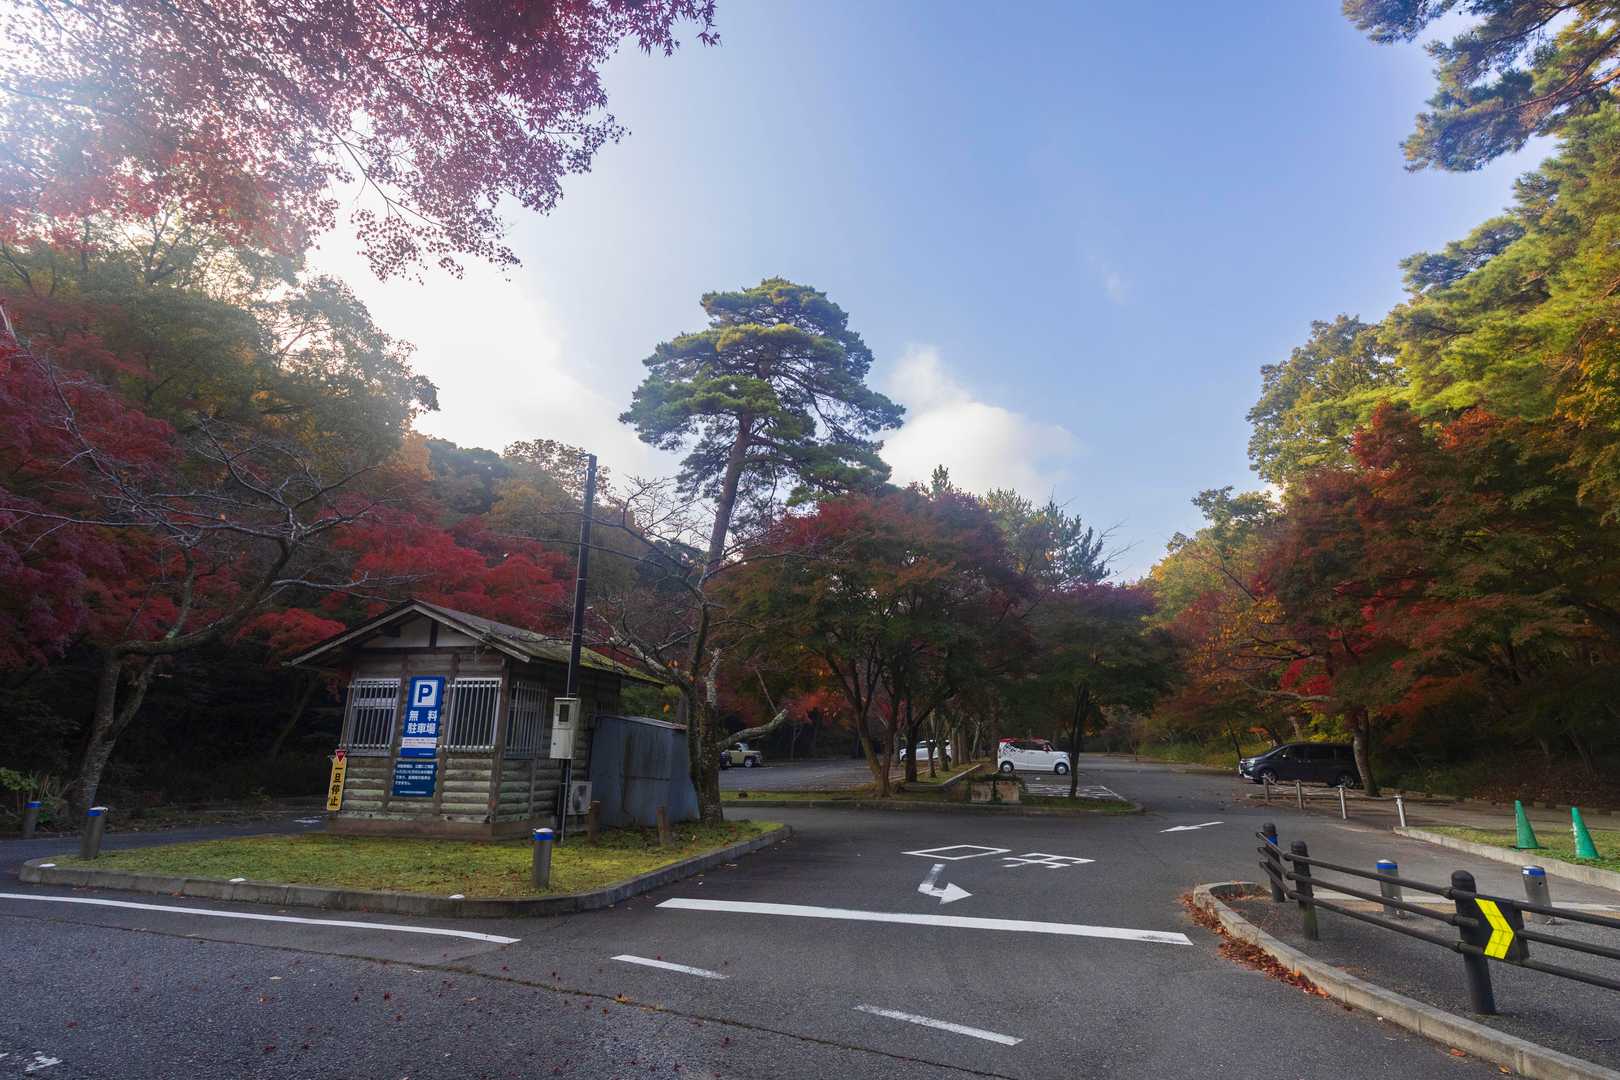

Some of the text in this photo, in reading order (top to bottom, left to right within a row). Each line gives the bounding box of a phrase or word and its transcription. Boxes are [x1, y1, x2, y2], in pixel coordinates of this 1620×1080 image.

[418, 684, 433, 703] P
[408, 710, 438, 722] 無料
[407, 723, 436, 734] 駐車場
[329, 767, 344, 806] 一旦停止
